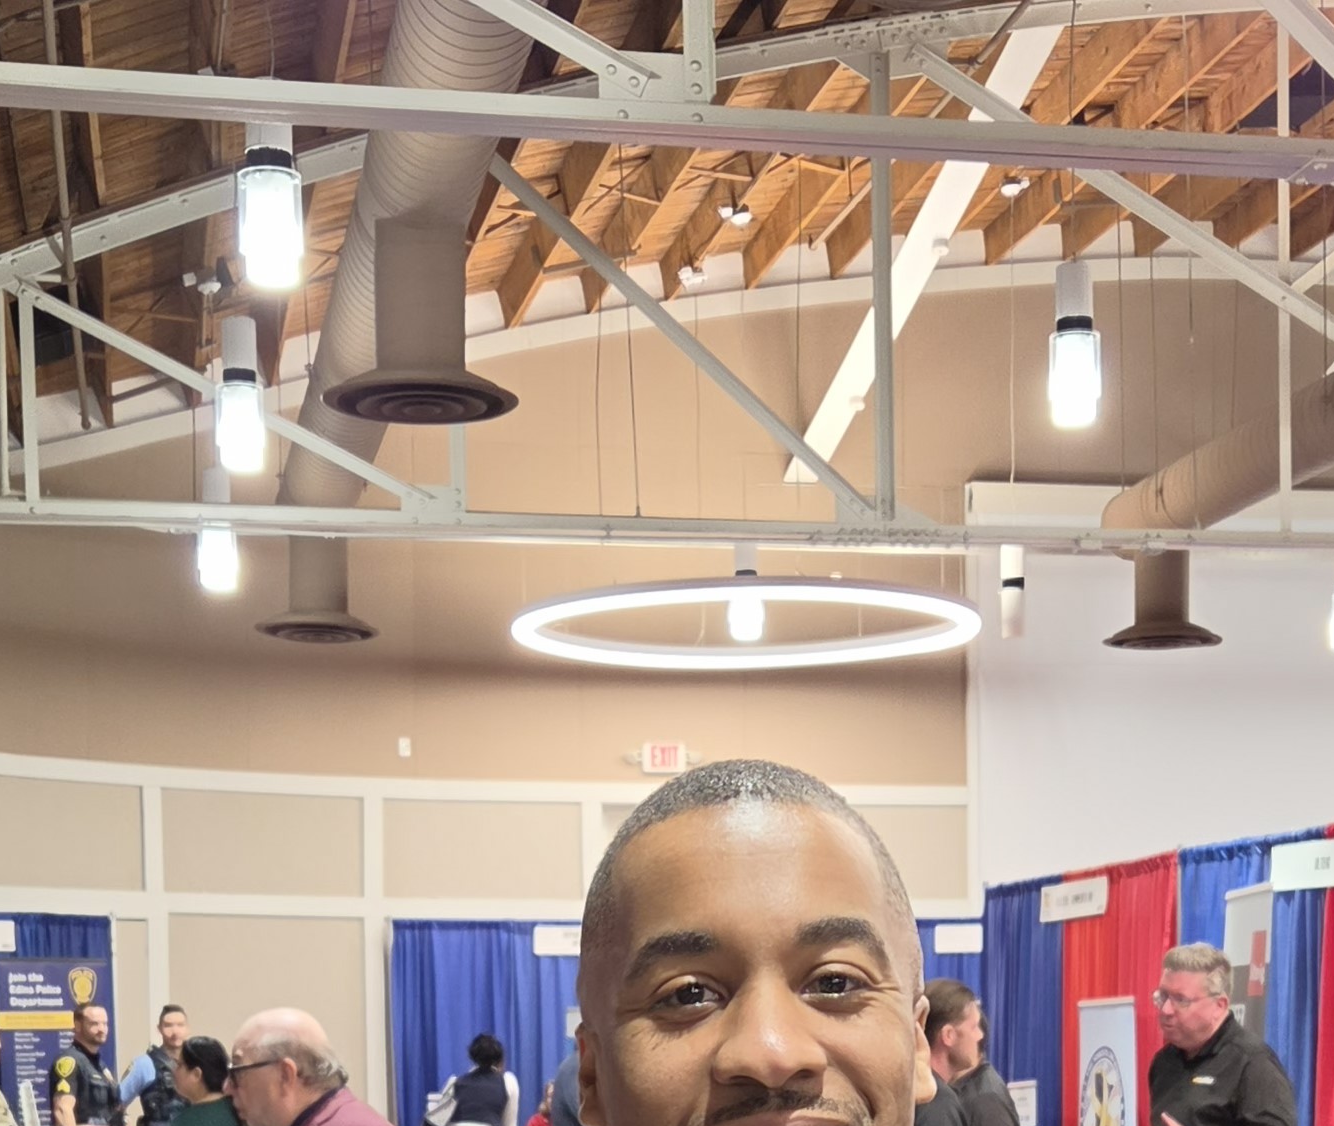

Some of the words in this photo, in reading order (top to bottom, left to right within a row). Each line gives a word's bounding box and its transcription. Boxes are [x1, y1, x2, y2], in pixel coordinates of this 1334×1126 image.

[650, 745, 679, 768] EXIT
[9, 972, 27, 984] Join
[27, 972, 44, 982] the
[9, 985, 35, 994] Edina
[35, 984, 62, 995] Police
[9, 997, 64, 1008] Department
